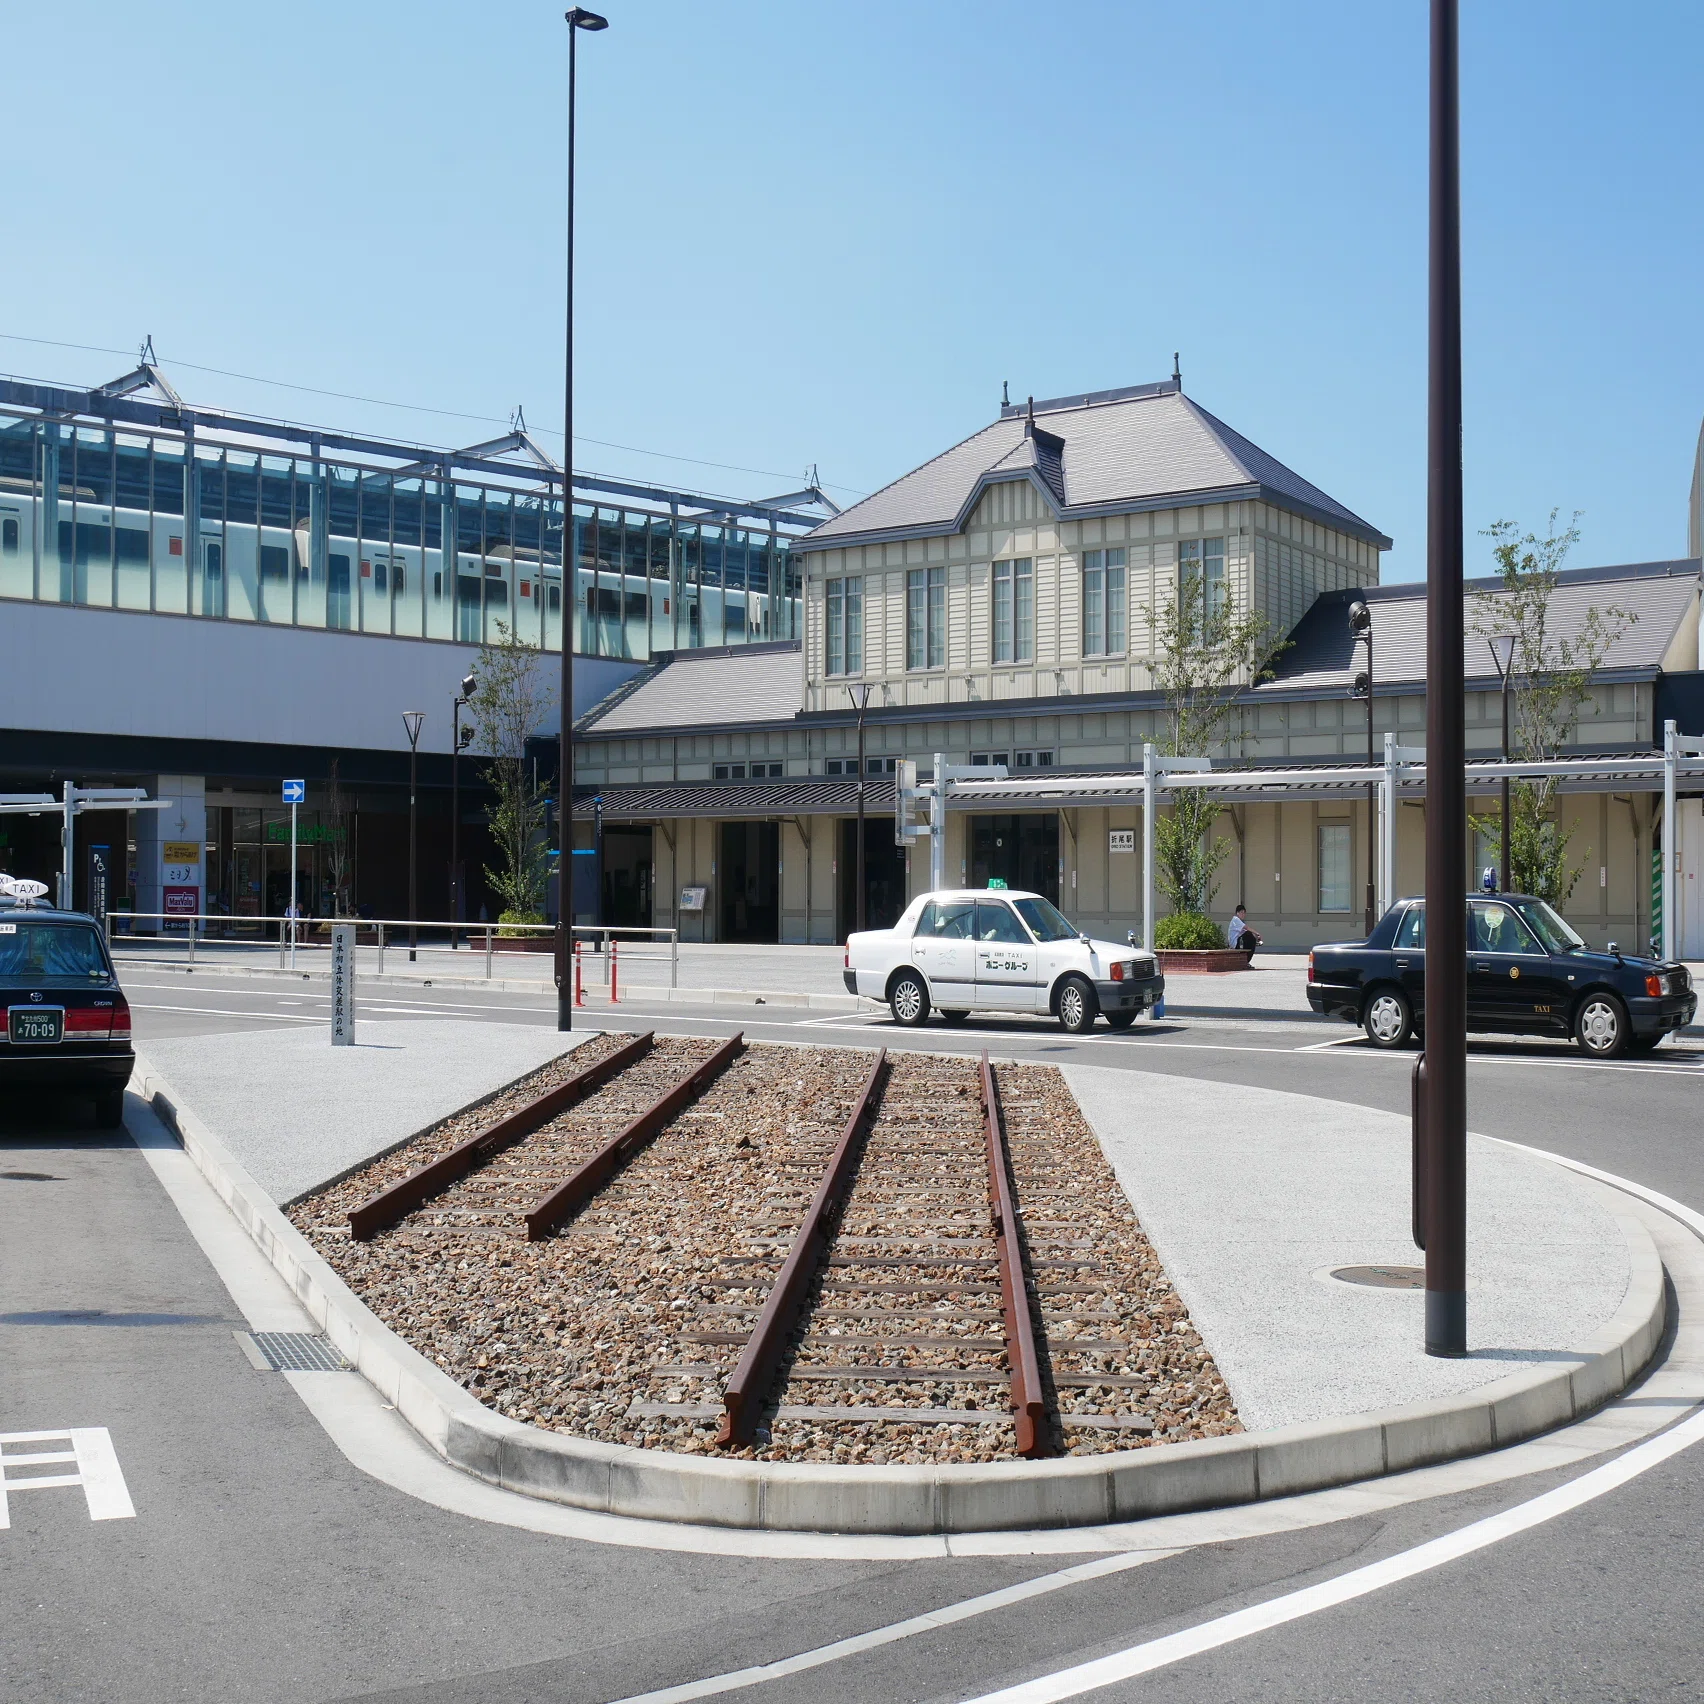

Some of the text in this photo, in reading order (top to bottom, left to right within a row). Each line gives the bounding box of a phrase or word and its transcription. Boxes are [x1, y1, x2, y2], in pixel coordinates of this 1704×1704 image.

[12, 884, 40, 893] TAXI
[168, 893, 193, 907] MaxValu
[335, 934, 344, 1036] 日本初立体交差駅の地
[1534, 1005, 1550, 1013] TAXI
[24, 1023, 55, 1037] 70-09
